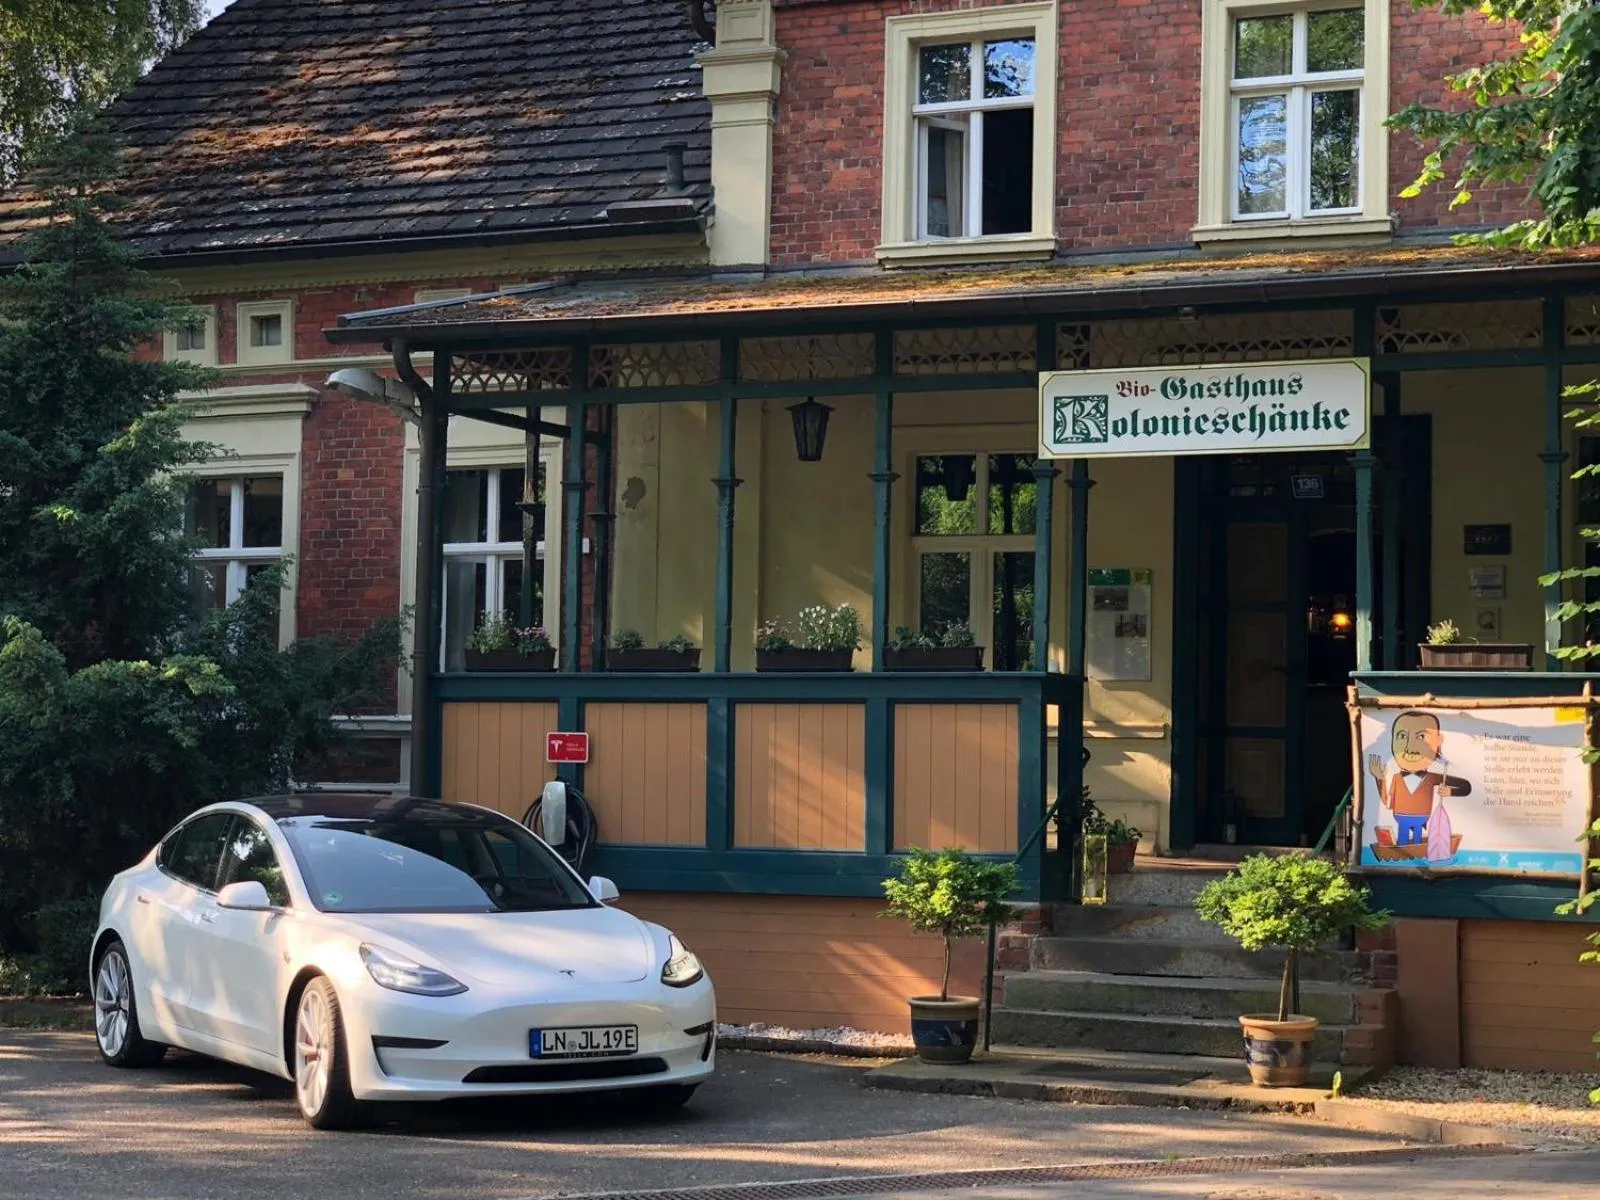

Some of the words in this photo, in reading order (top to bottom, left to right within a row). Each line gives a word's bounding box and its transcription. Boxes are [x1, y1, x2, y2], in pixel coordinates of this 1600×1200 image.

[1115, 380, 1156, 399] Bio-
[1159, 372, 1303, 402] Gasthaus
[1053, 395, 1350, 444] Kolonieschänke
[542, 1031, 566, 1051] LN
